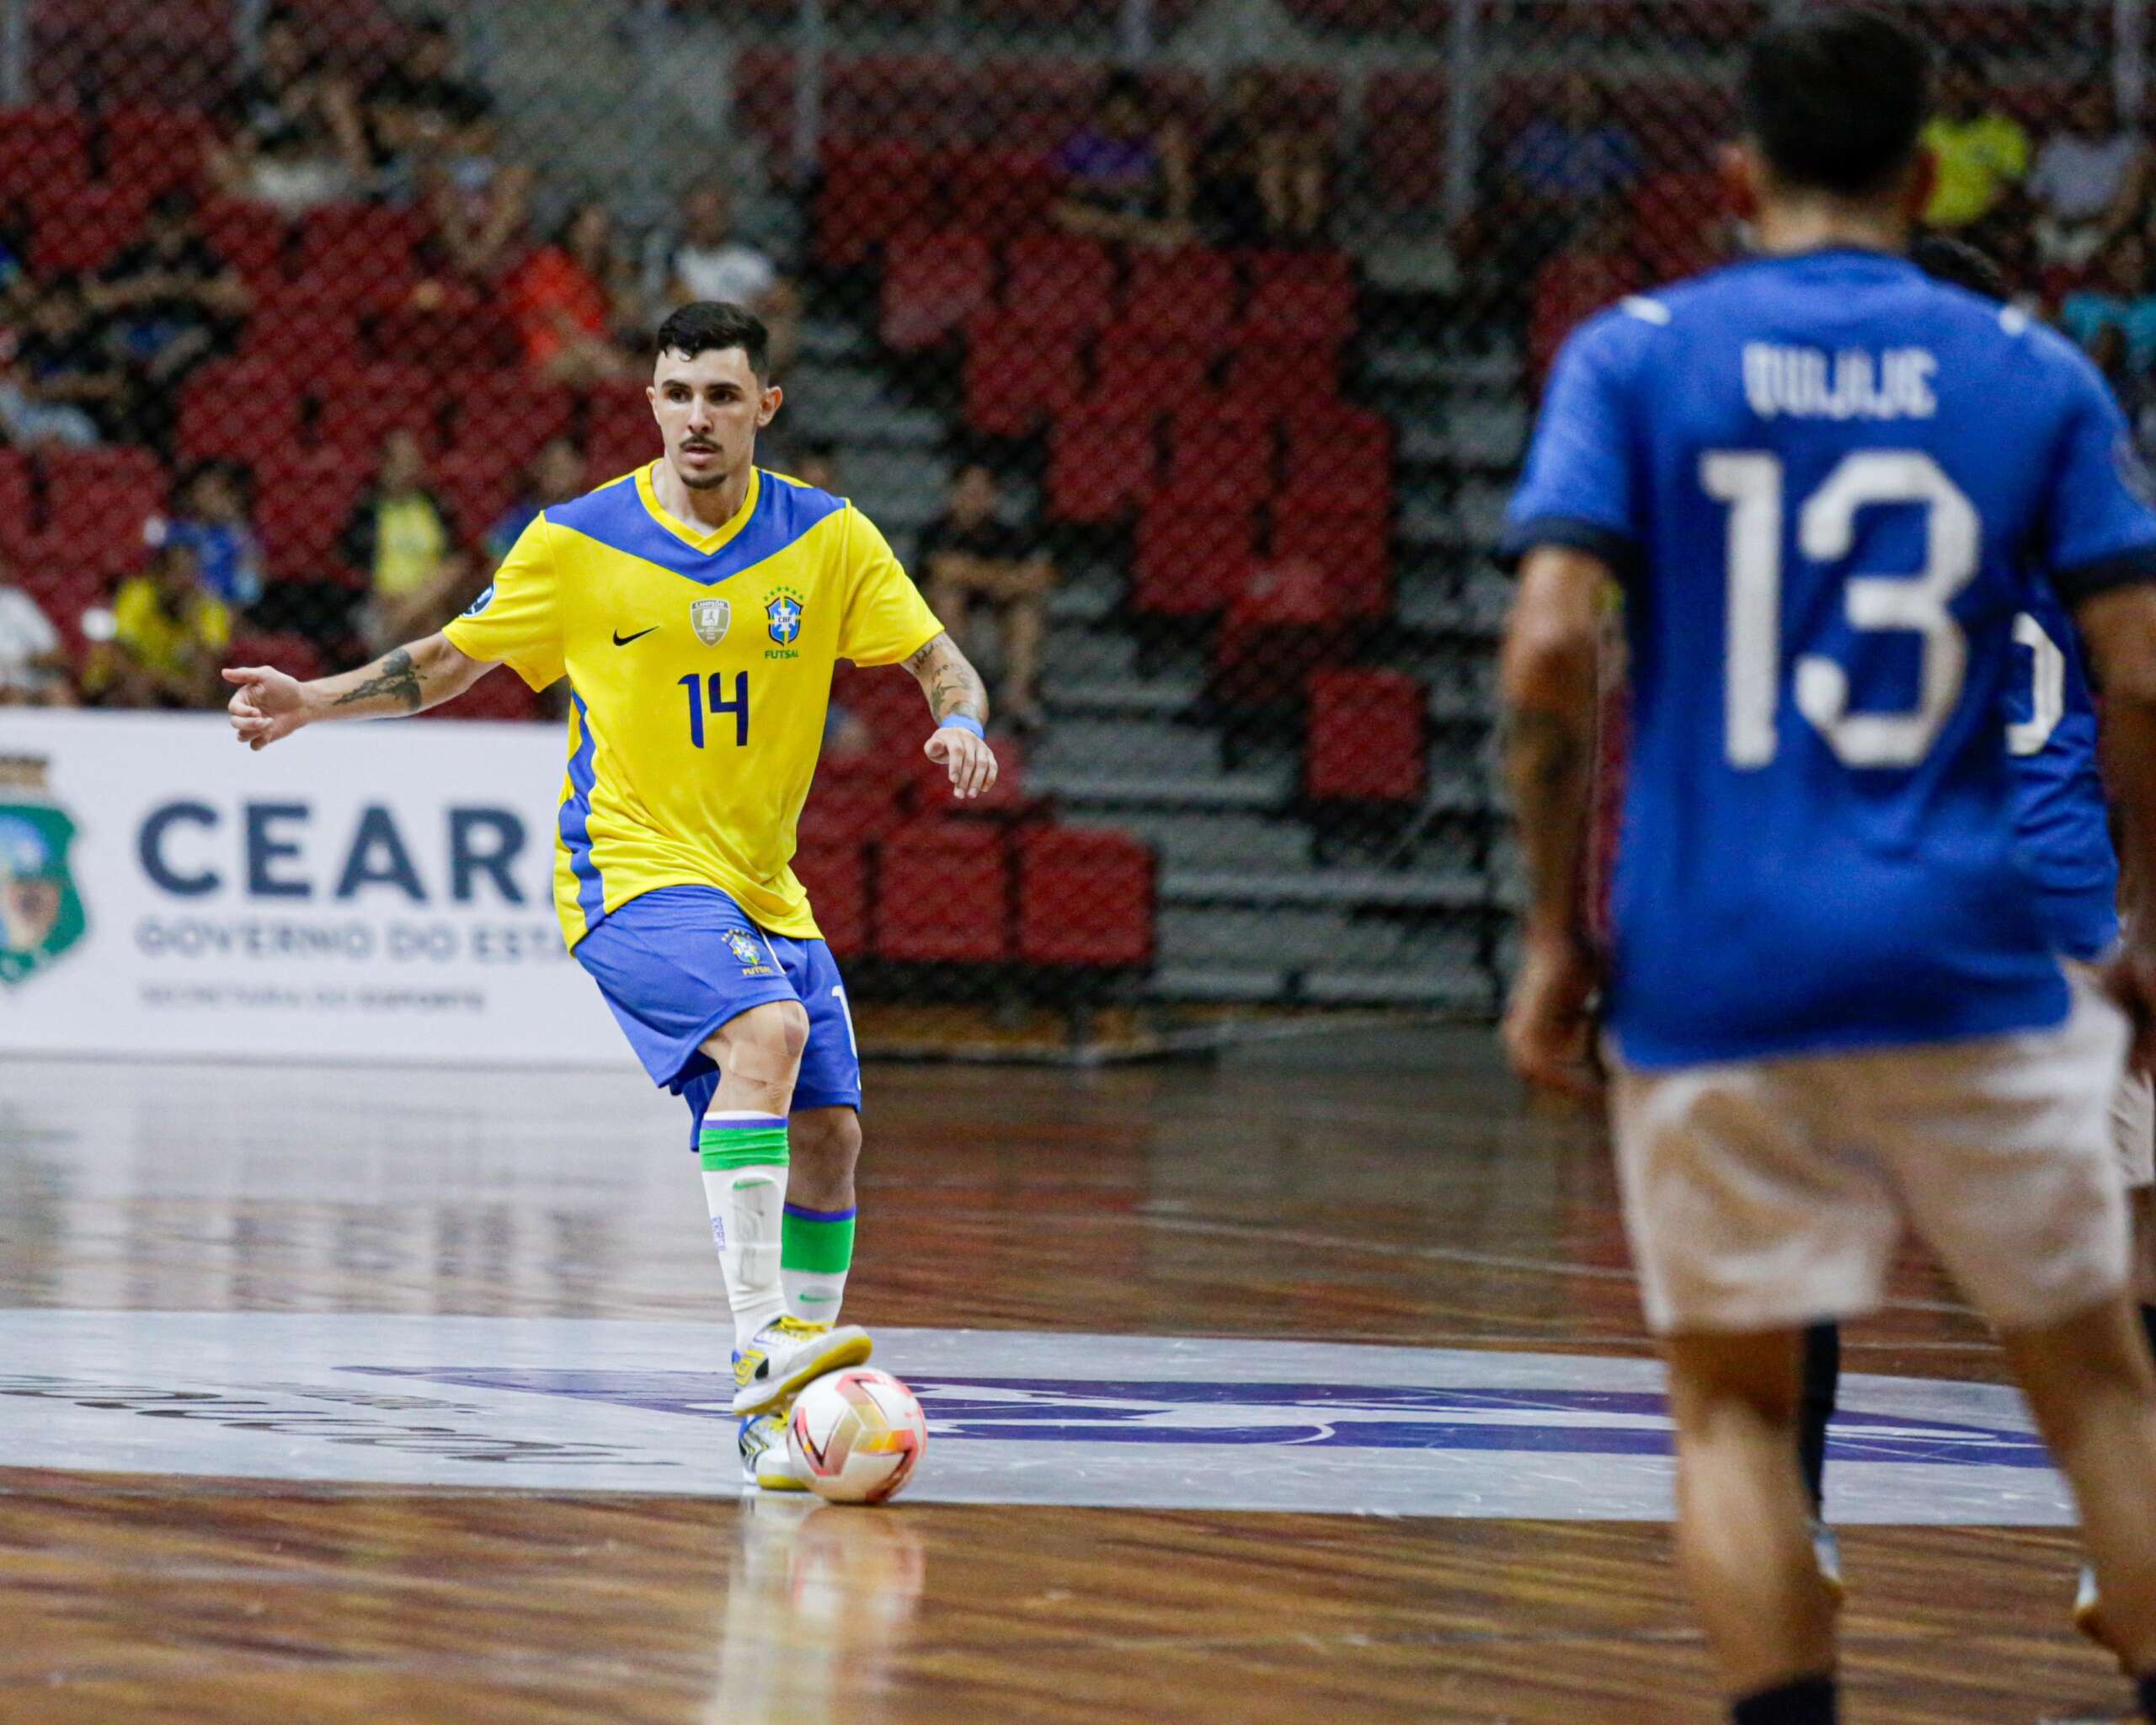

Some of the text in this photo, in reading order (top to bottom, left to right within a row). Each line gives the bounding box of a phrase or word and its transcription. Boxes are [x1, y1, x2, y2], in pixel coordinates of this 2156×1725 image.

[764, 649, 799, 660] FUTSAL
[1700, 450, 1981, 770] 13
[677, 670, 748, 748] 14
[139, 800, 558, 906] CEAR
